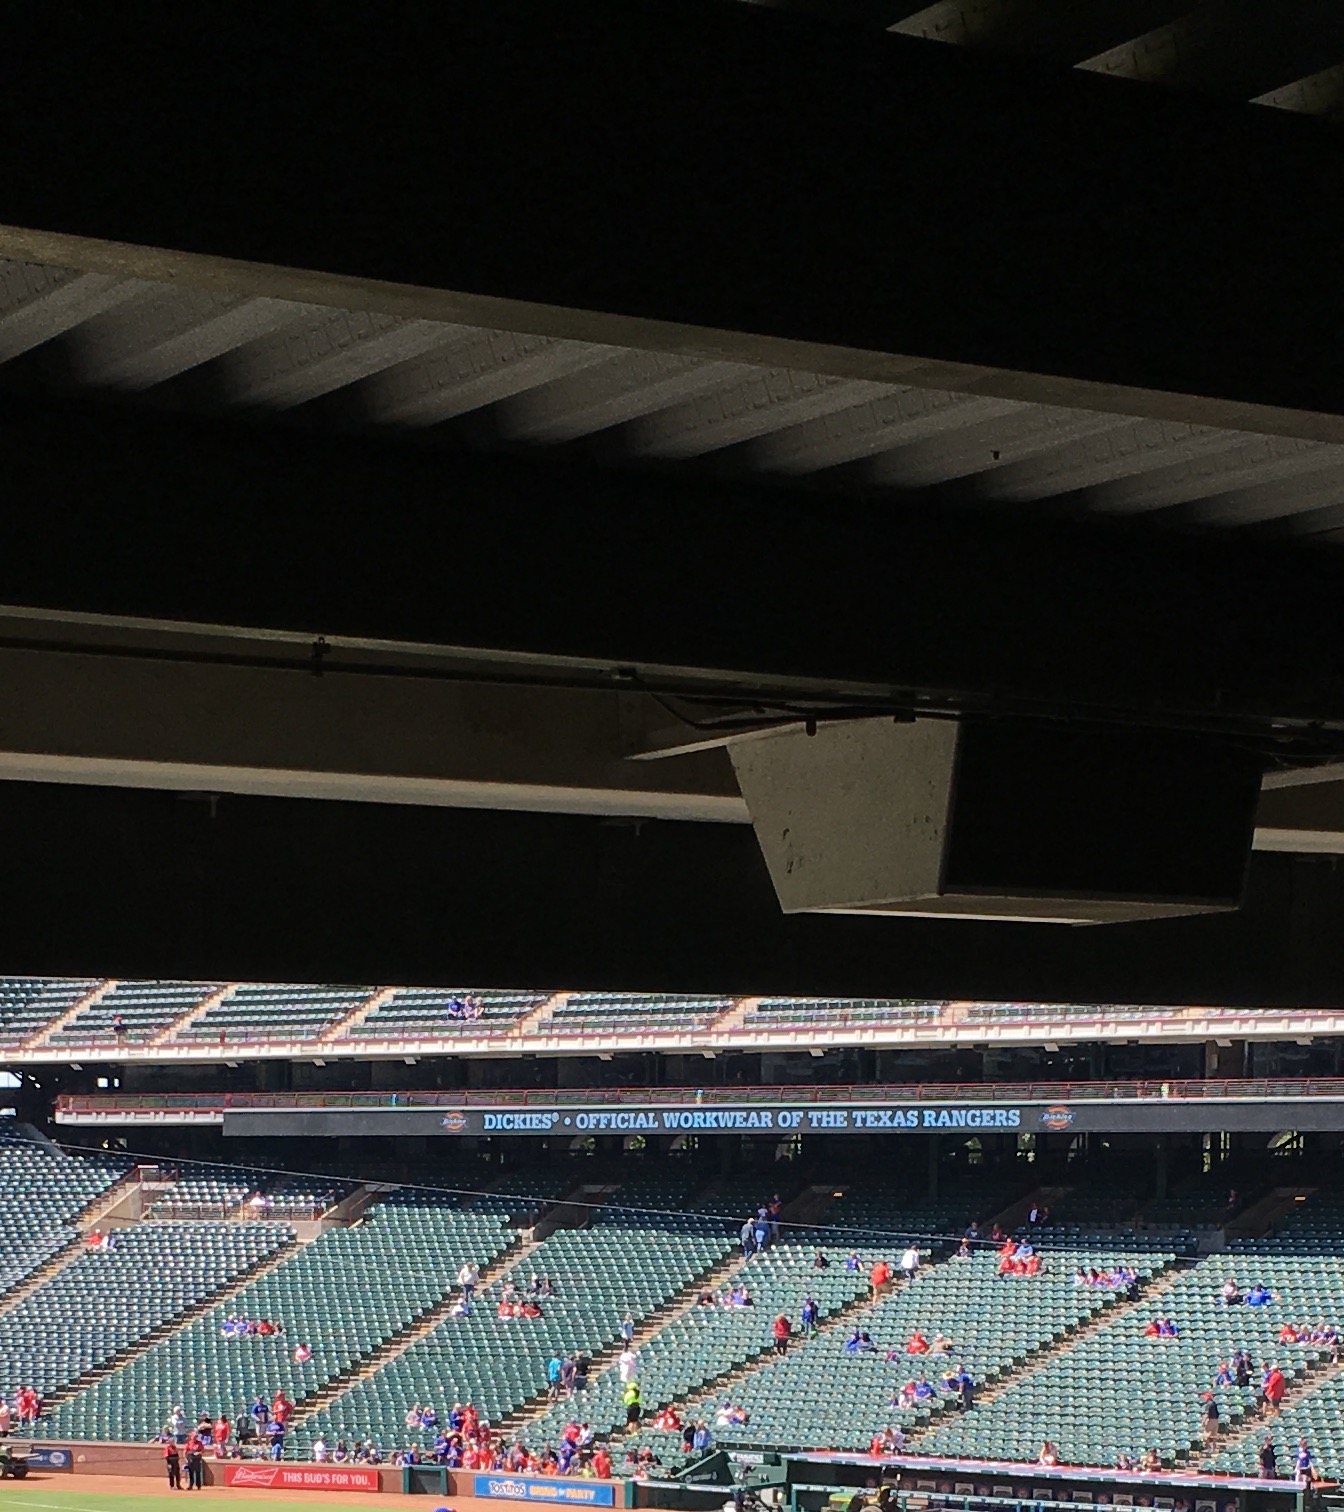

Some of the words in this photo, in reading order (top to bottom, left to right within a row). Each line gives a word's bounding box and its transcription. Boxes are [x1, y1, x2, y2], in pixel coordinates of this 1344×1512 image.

[576, 1112, 659, 1129] OFFICIAL
[663, 1111, 773, 1129] WORKWEAR
[777, 1111, 804, 1128] OF
[808, 1110, 848, 1128] THE
[853, 1110, 921, 1128] TEXAS
[923, 1109, 1021, 1128] RANGERS
[283, 1472, 303, 1483] THIS
[305, 1472, 330, 1484] BUD'S
[332, 1474, 349, 1484] FOR
[350, 1474, 371, 1486] YOU.
